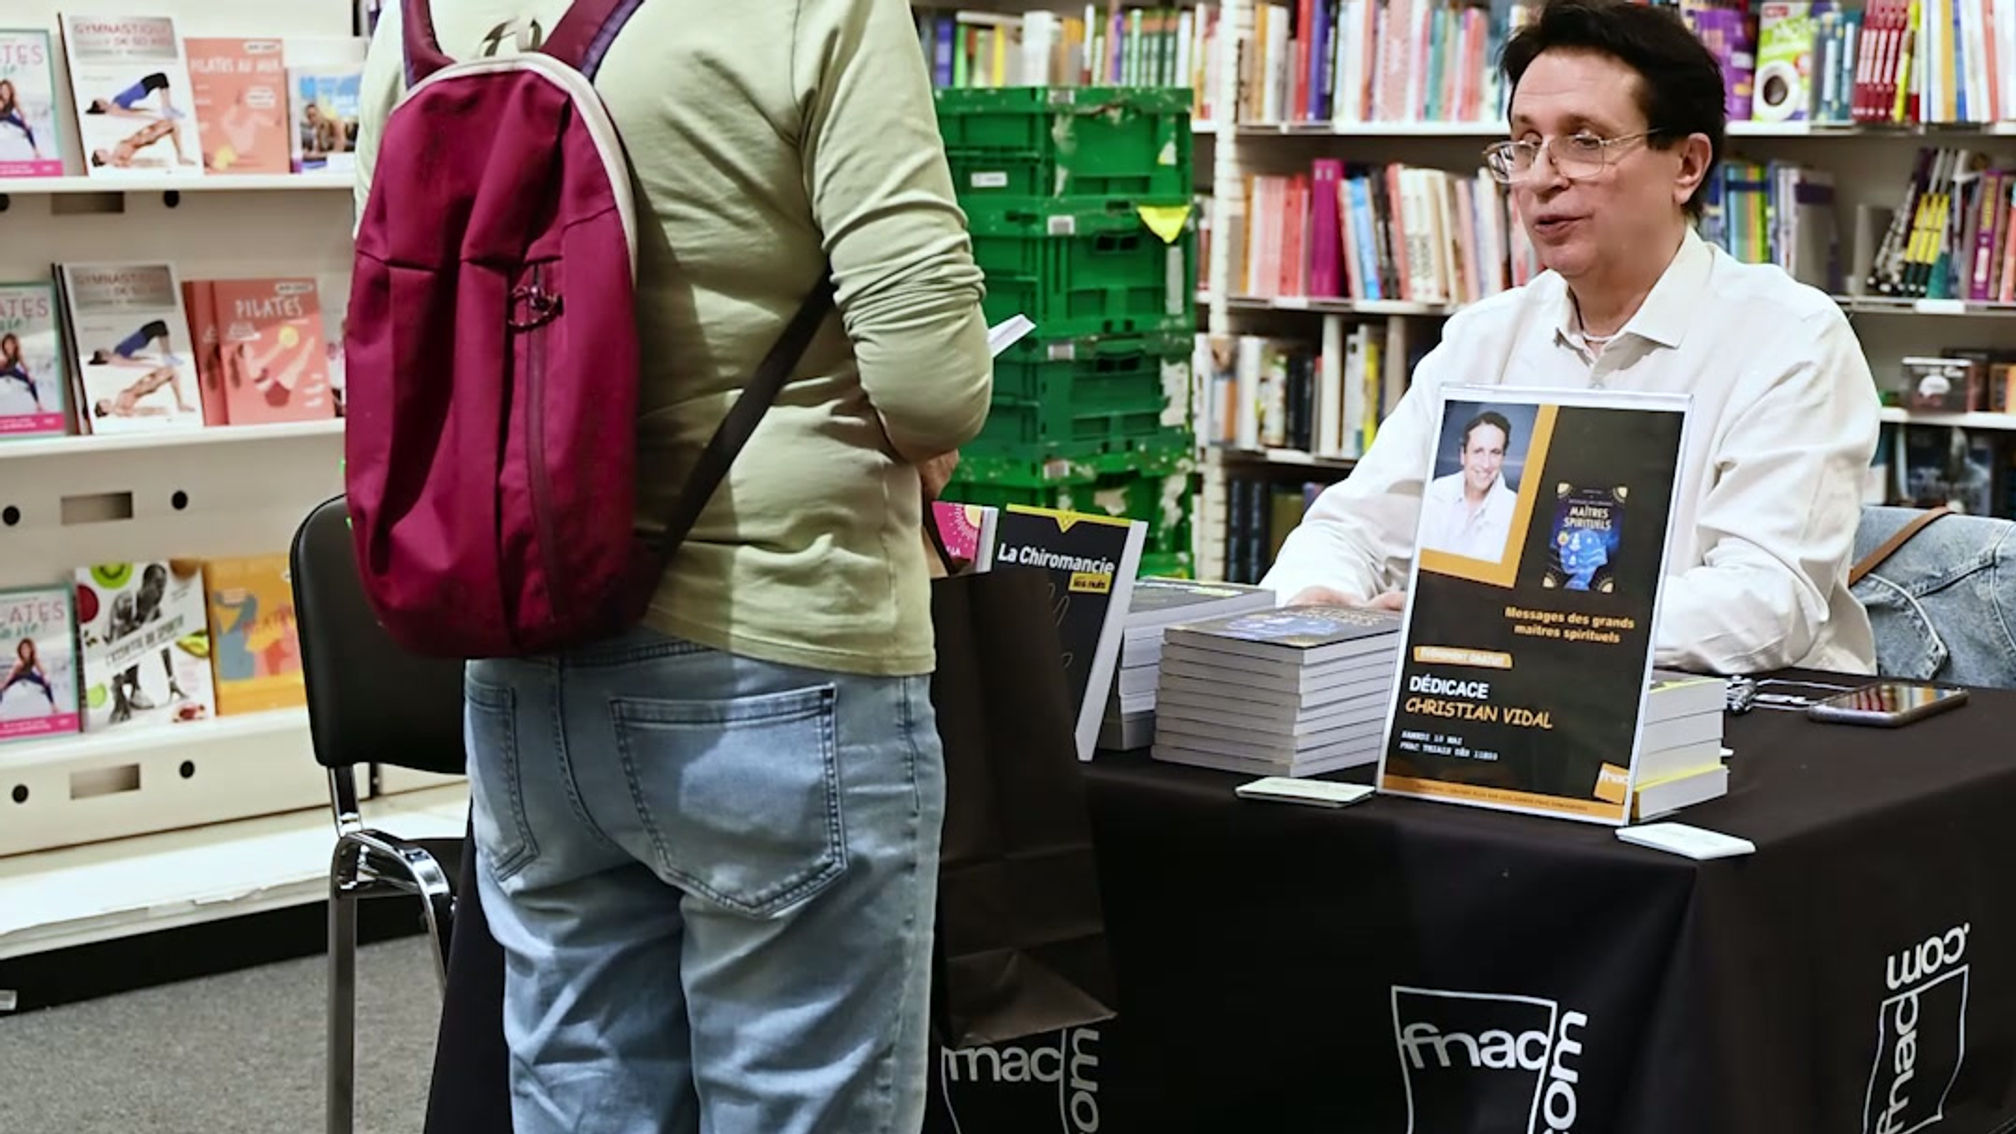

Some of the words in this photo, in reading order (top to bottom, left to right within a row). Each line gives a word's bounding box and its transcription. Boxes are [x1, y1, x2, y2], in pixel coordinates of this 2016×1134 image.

[0, 44, 44, 65] TES
[235, 296, 302, 318] PILATES
[1563, 517, 1613, 531] SPIRITUELS
[997, 542, 1017, 563] La
[1019, 546, 1115, 574] Chiromancie
[0, 601, 65, 624] ATES
[1505, 606, 1565, 624] Messages
[1567, 613, 1590, 625] des
[1592, 617, 1635, 629] grands
[1563, 629, 1620, 643] spirituels
[1409, 673, 1490, 699] DÉDICACE
[1405, 697, 1499, 722] CHRISTIAN
[1502, 707, 1553, 729] VIDAL
[1401, 1022, 1549, 1070] fnac
[1069, 1028, 1100, 1134] om
[1543, 1010, 1588, 1134] om
